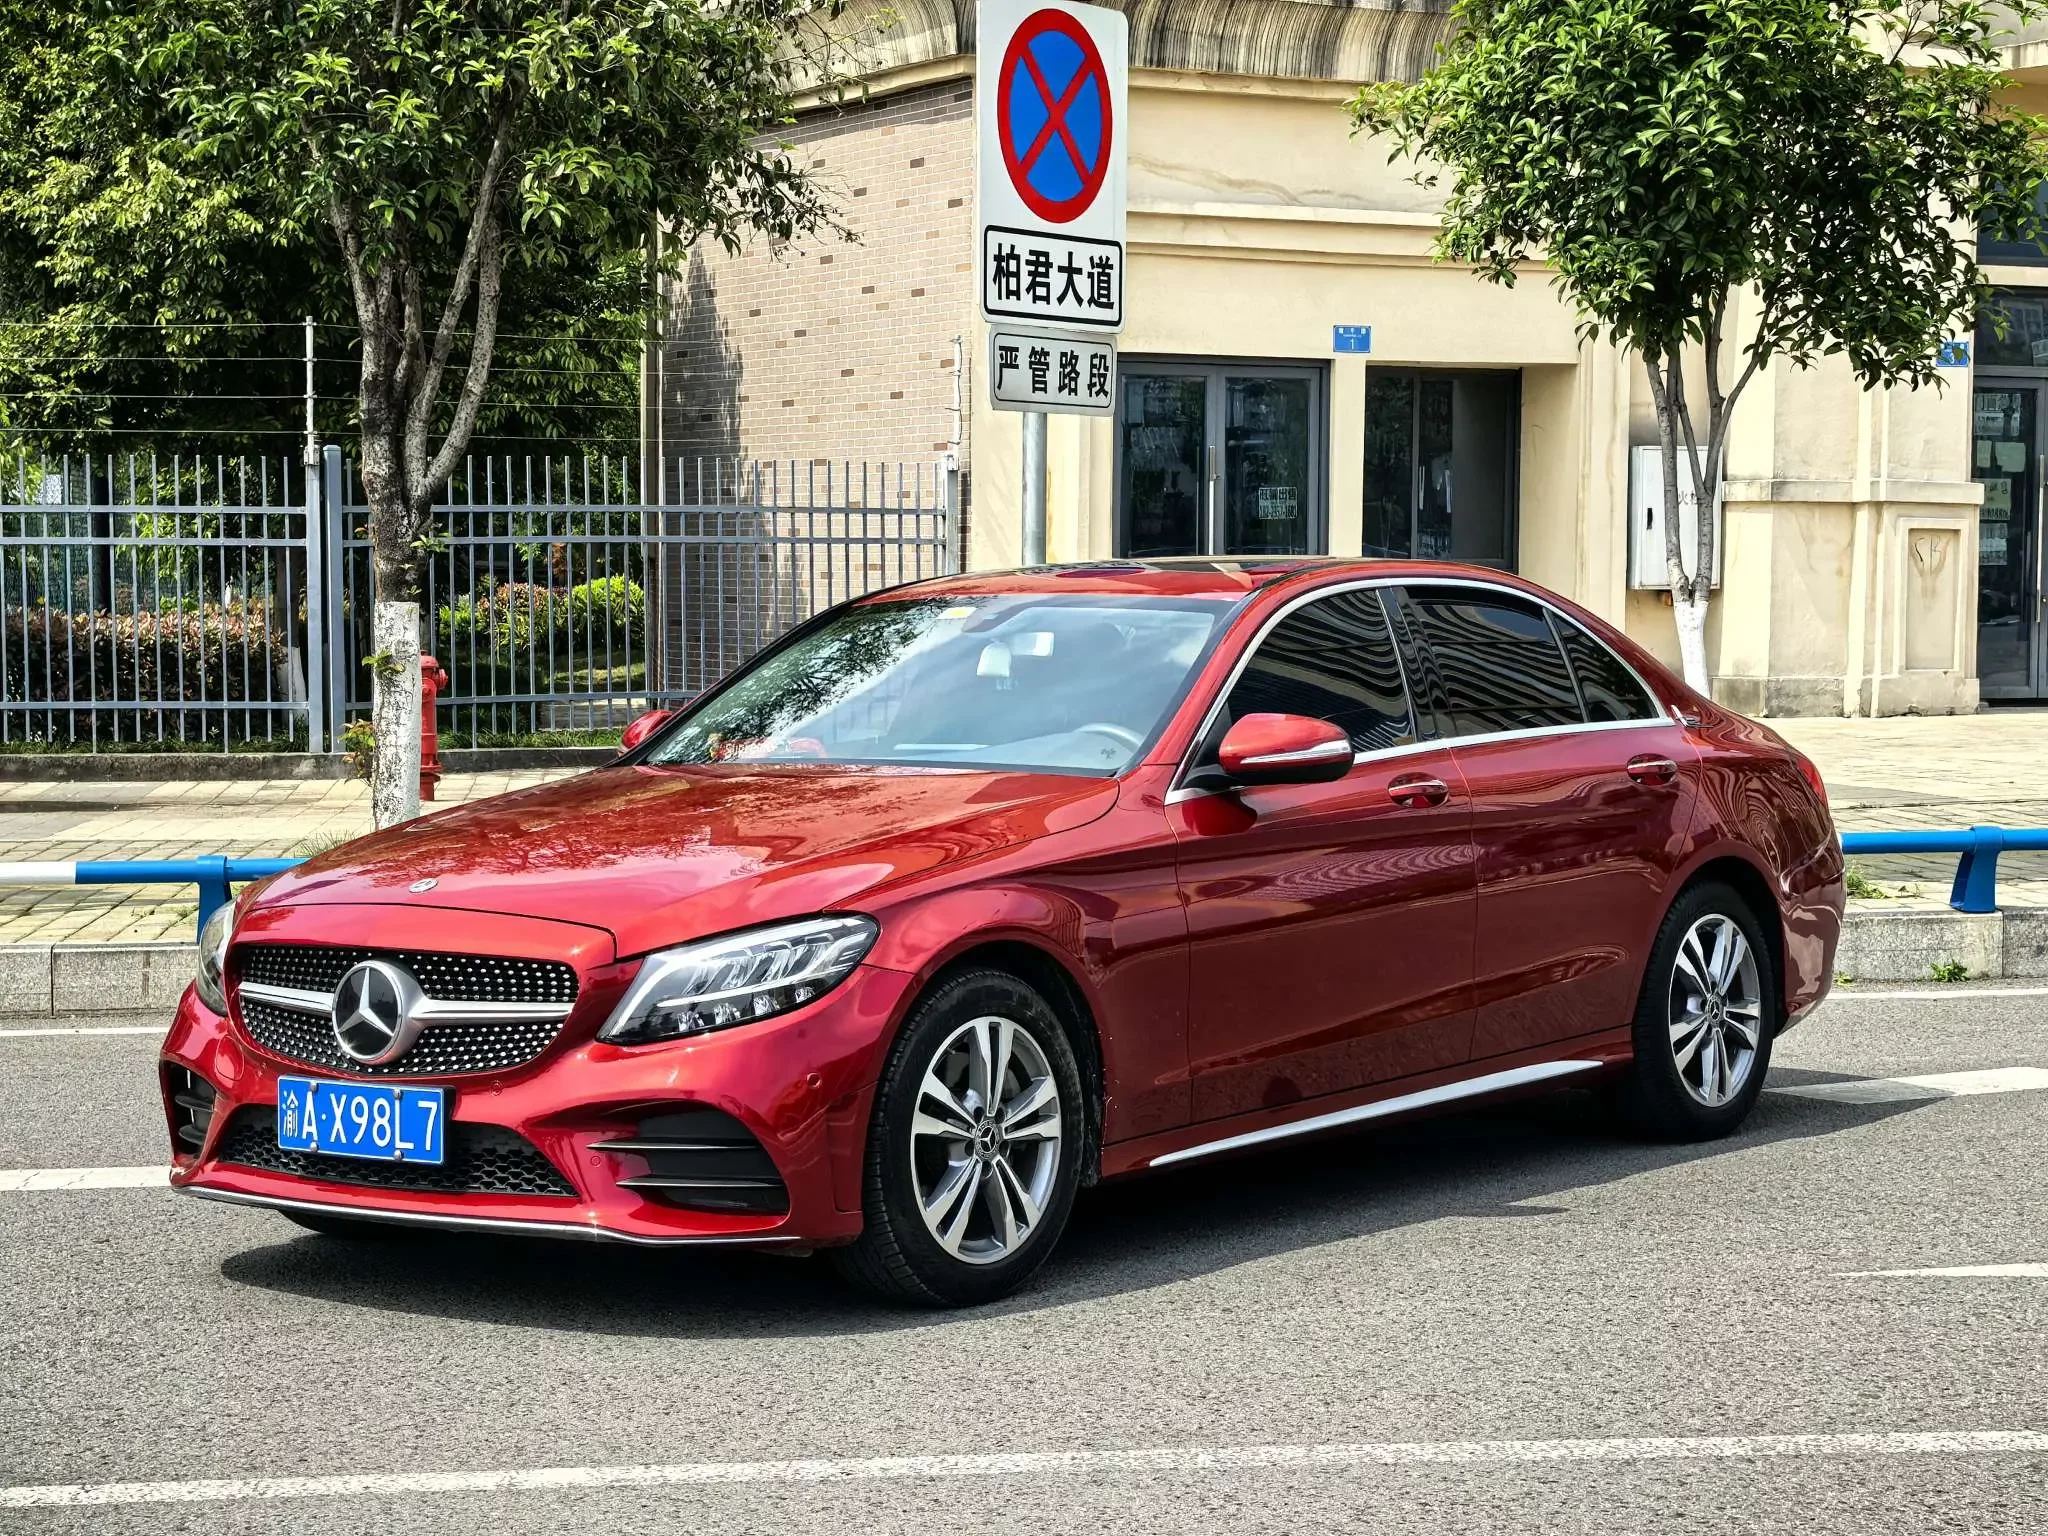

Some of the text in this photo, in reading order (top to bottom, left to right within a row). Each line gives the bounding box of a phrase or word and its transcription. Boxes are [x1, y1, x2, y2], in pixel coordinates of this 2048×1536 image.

[993, 242, 1114, 310] 柏君大道
[997, 345, 1109, 398] 严管路段
